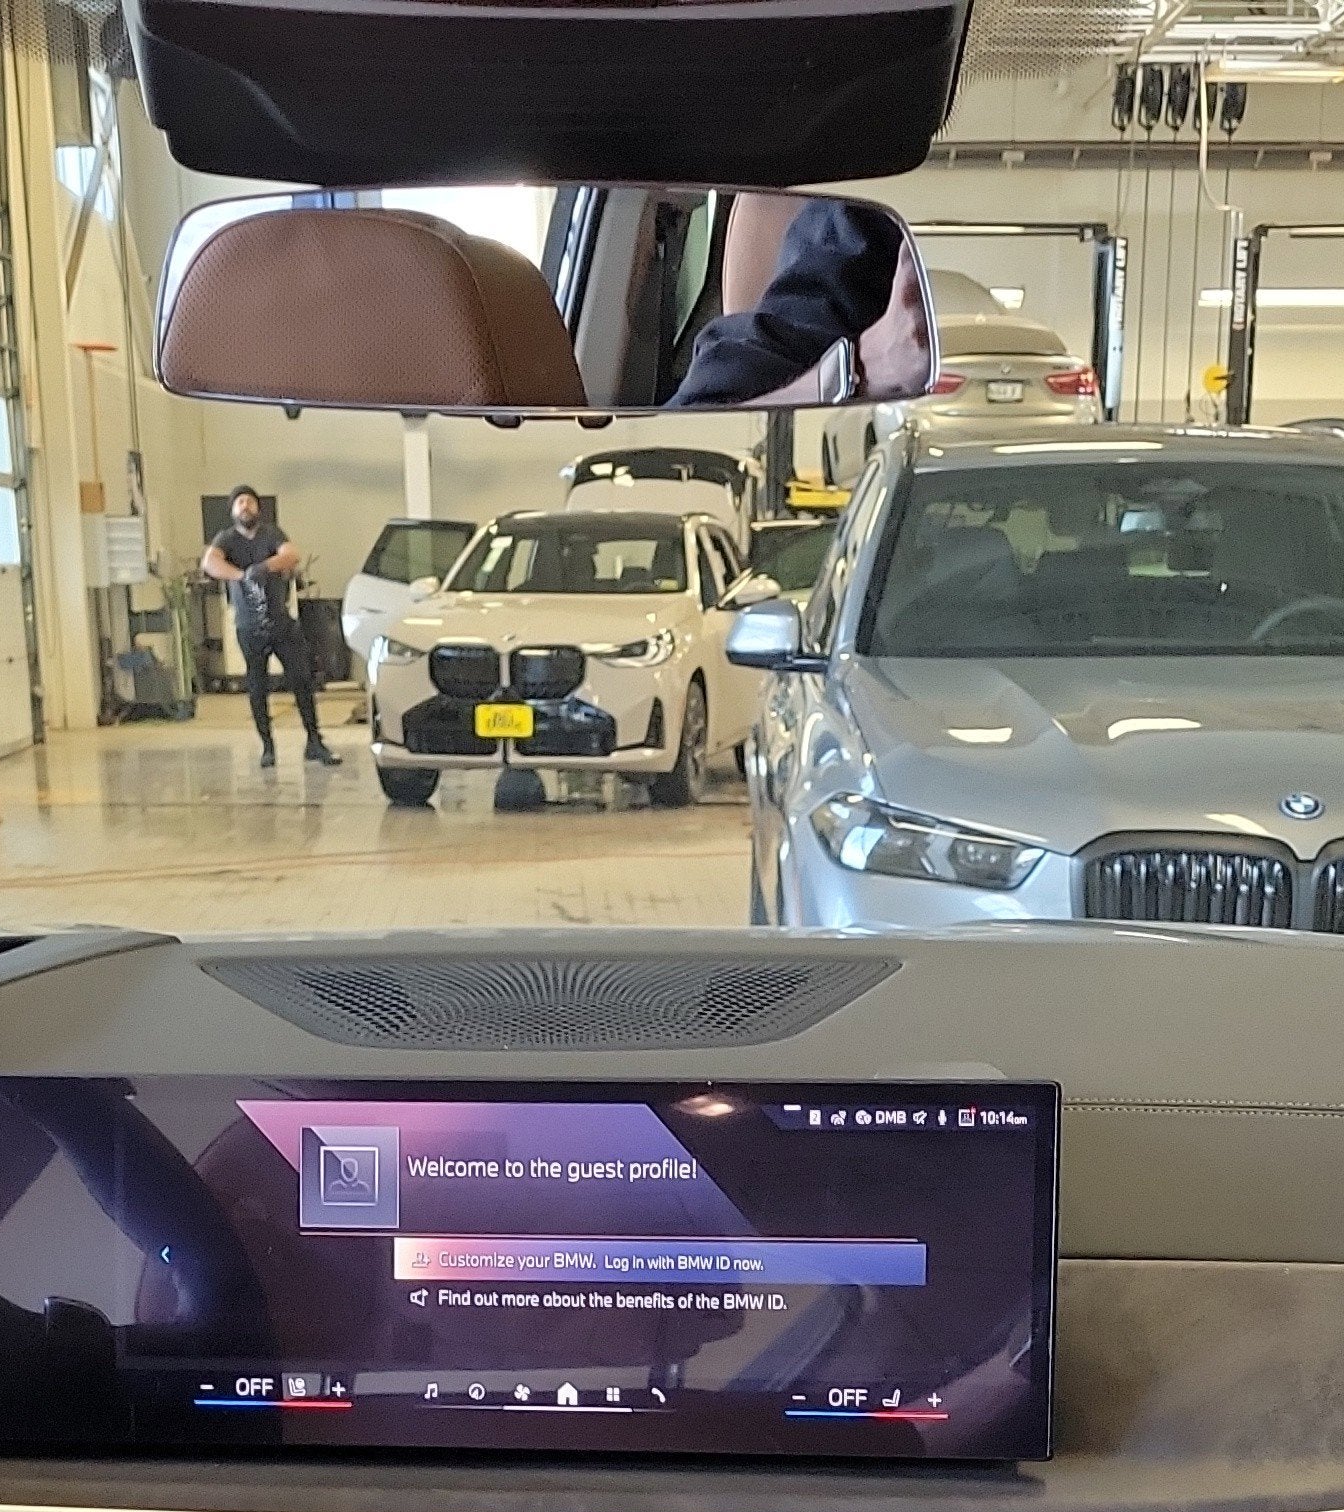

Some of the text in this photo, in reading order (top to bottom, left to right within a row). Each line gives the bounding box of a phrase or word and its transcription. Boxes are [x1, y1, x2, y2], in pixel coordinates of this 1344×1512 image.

[875, 1110, 906, 1124] DMB
[407, 1156, 697, 1182] Welcome to the guest profile!
[438, 1251, 597, 1271] Customize your BMW.
[605, 1255, 764, 1272] Log in with BMW ID now.
[438, 1289, 787, 1310] Find out more about the benefits of the BMW ID.
[235, 1377, 274, 1397] OFF
[828, 1387, 869, 1407] OFF
